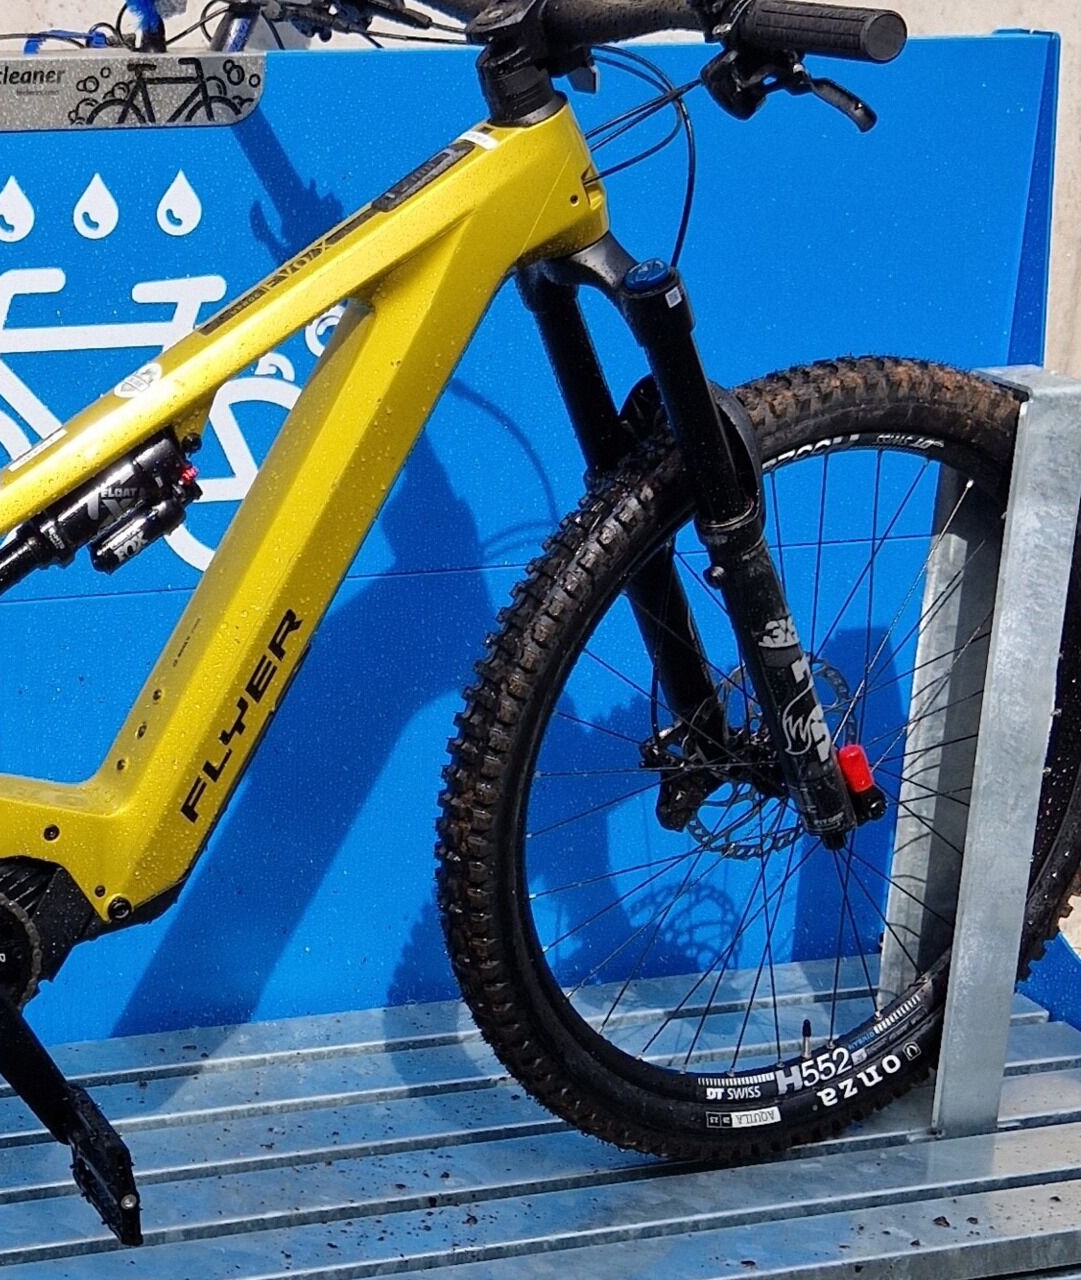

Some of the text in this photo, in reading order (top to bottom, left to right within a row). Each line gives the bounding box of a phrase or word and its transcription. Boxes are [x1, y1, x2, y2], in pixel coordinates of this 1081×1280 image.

[180, 608, 303, 823] FLYER
[705, 1087, 725, 1101] DT
[727, 1085, 762, 1101] SWISS
[776, 1046, 853, 1095] H552
[816, 1054, 902, 1107] onza
[735, 1110, 775, 1124] AQUILA
